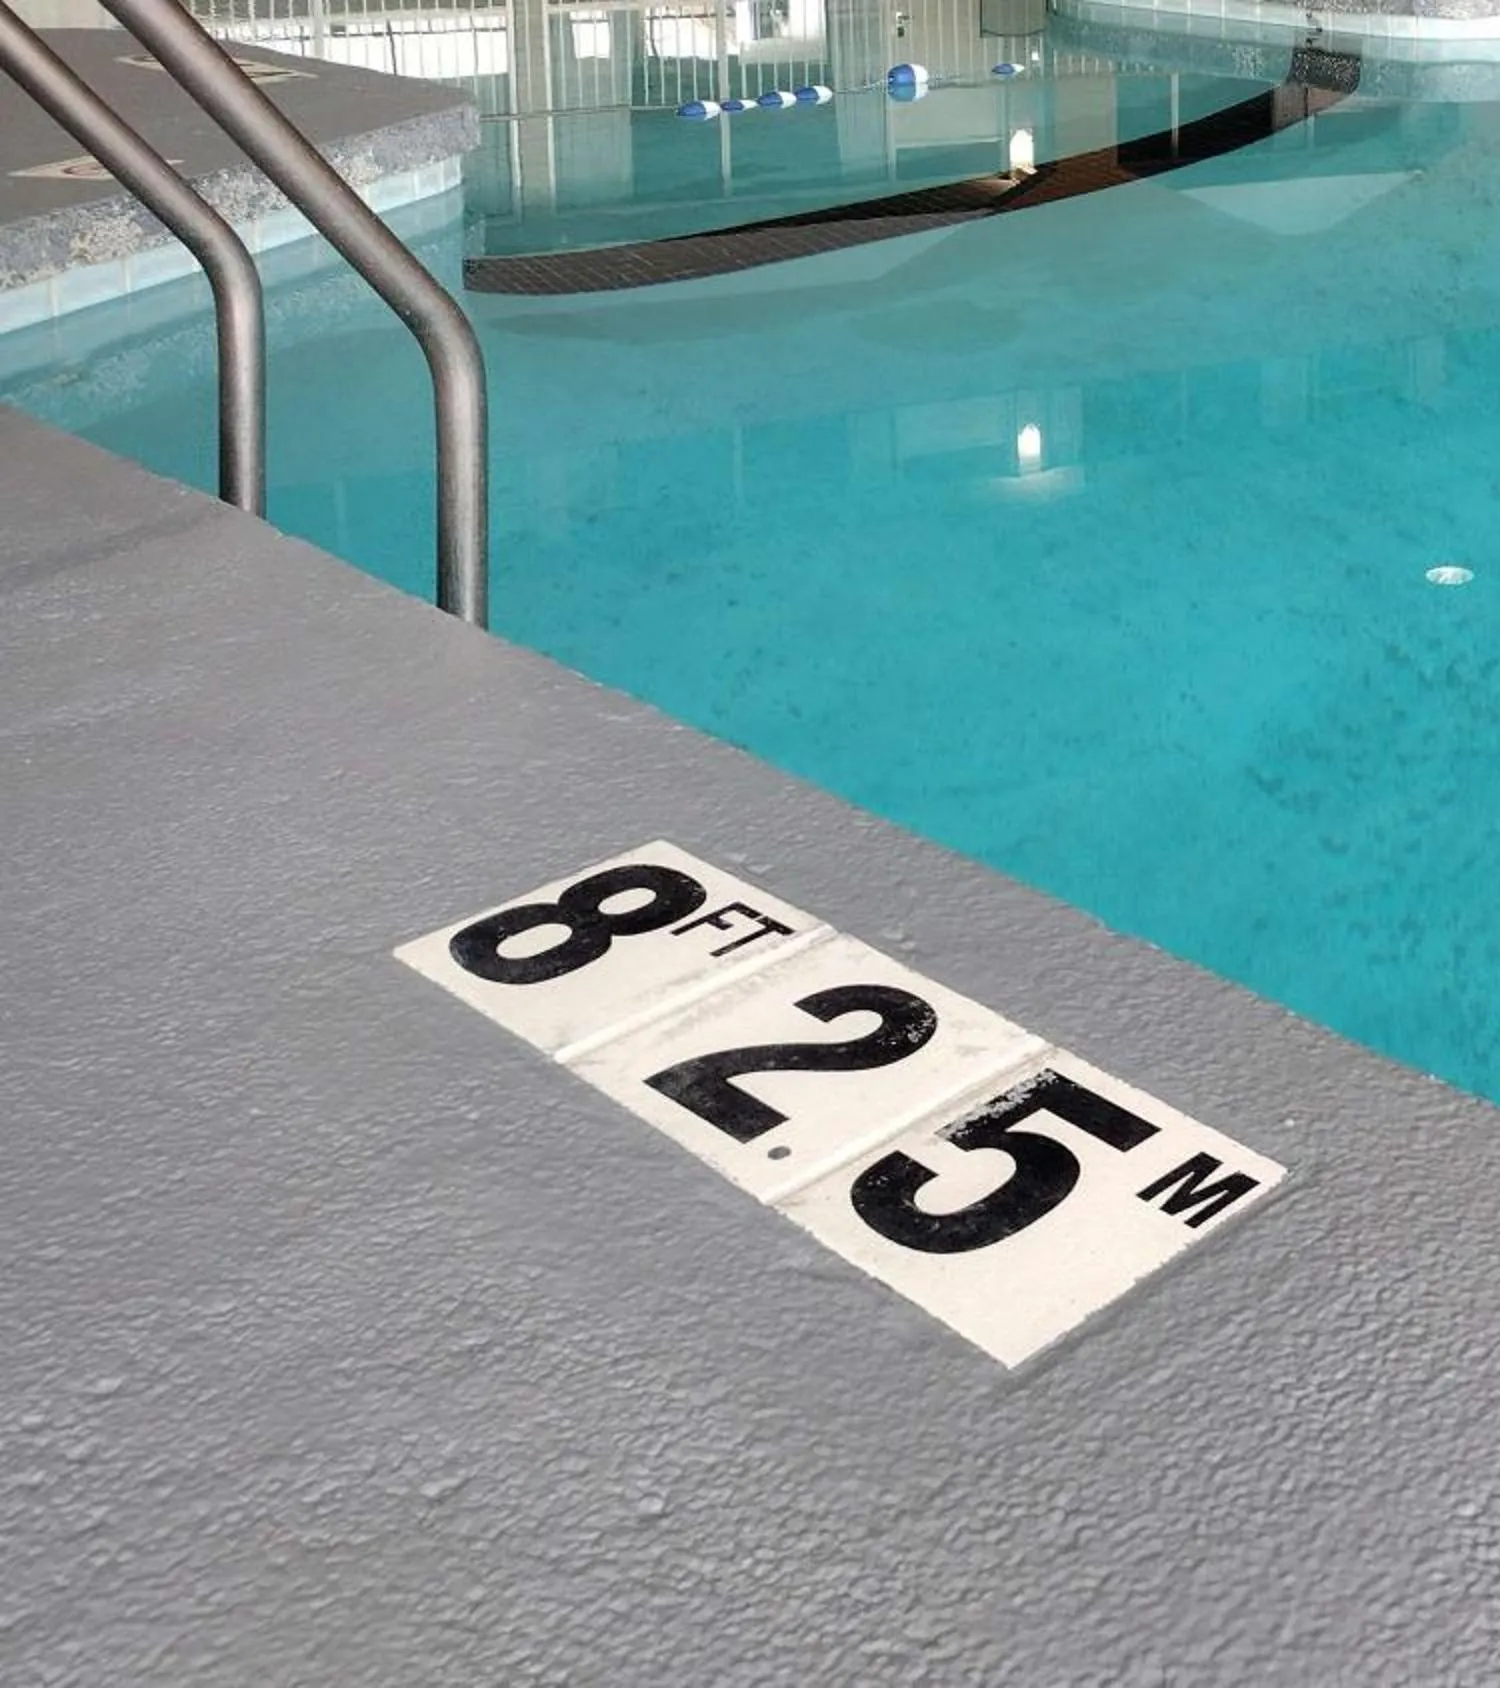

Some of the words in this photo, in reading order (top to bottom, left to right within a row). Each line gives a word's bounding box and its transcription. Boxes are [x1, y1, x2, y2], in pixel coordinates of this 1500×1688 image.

[449, 864, 707, 985] 8
[671, 902, 795, 957] FT
[1136, 1151, 1261, 1229] M
